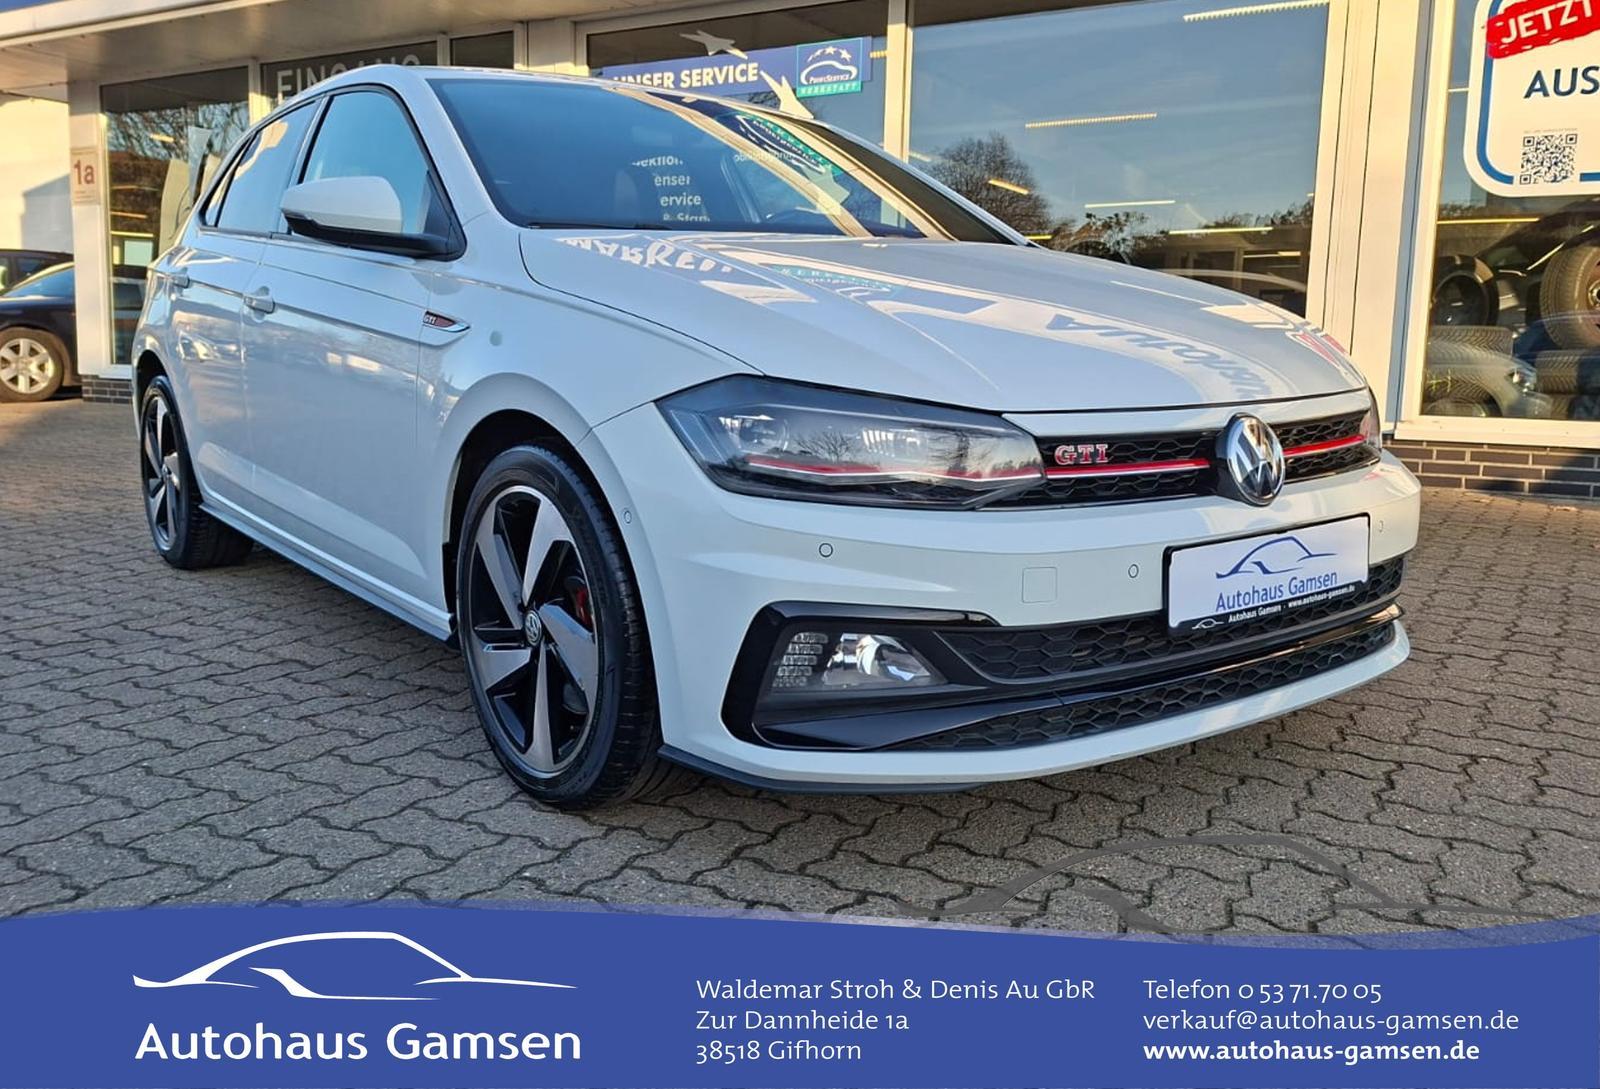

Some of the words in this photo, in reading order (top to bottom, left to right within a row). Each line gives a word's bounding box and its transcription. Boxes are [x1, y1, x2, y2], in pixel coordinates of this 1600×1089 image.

[680, 63, 759, 89] SERVICE
[1523, 66, 1600, 99] AUS
[74, 160, 95, 184] 1a
[1054, 444, 1109, 466] GTI
[1216, 584, 1284, 612] Autohaus
[1288, 572, 1338, 595] Gamsen
[1228, 610, 1257, 623] Autohaus
